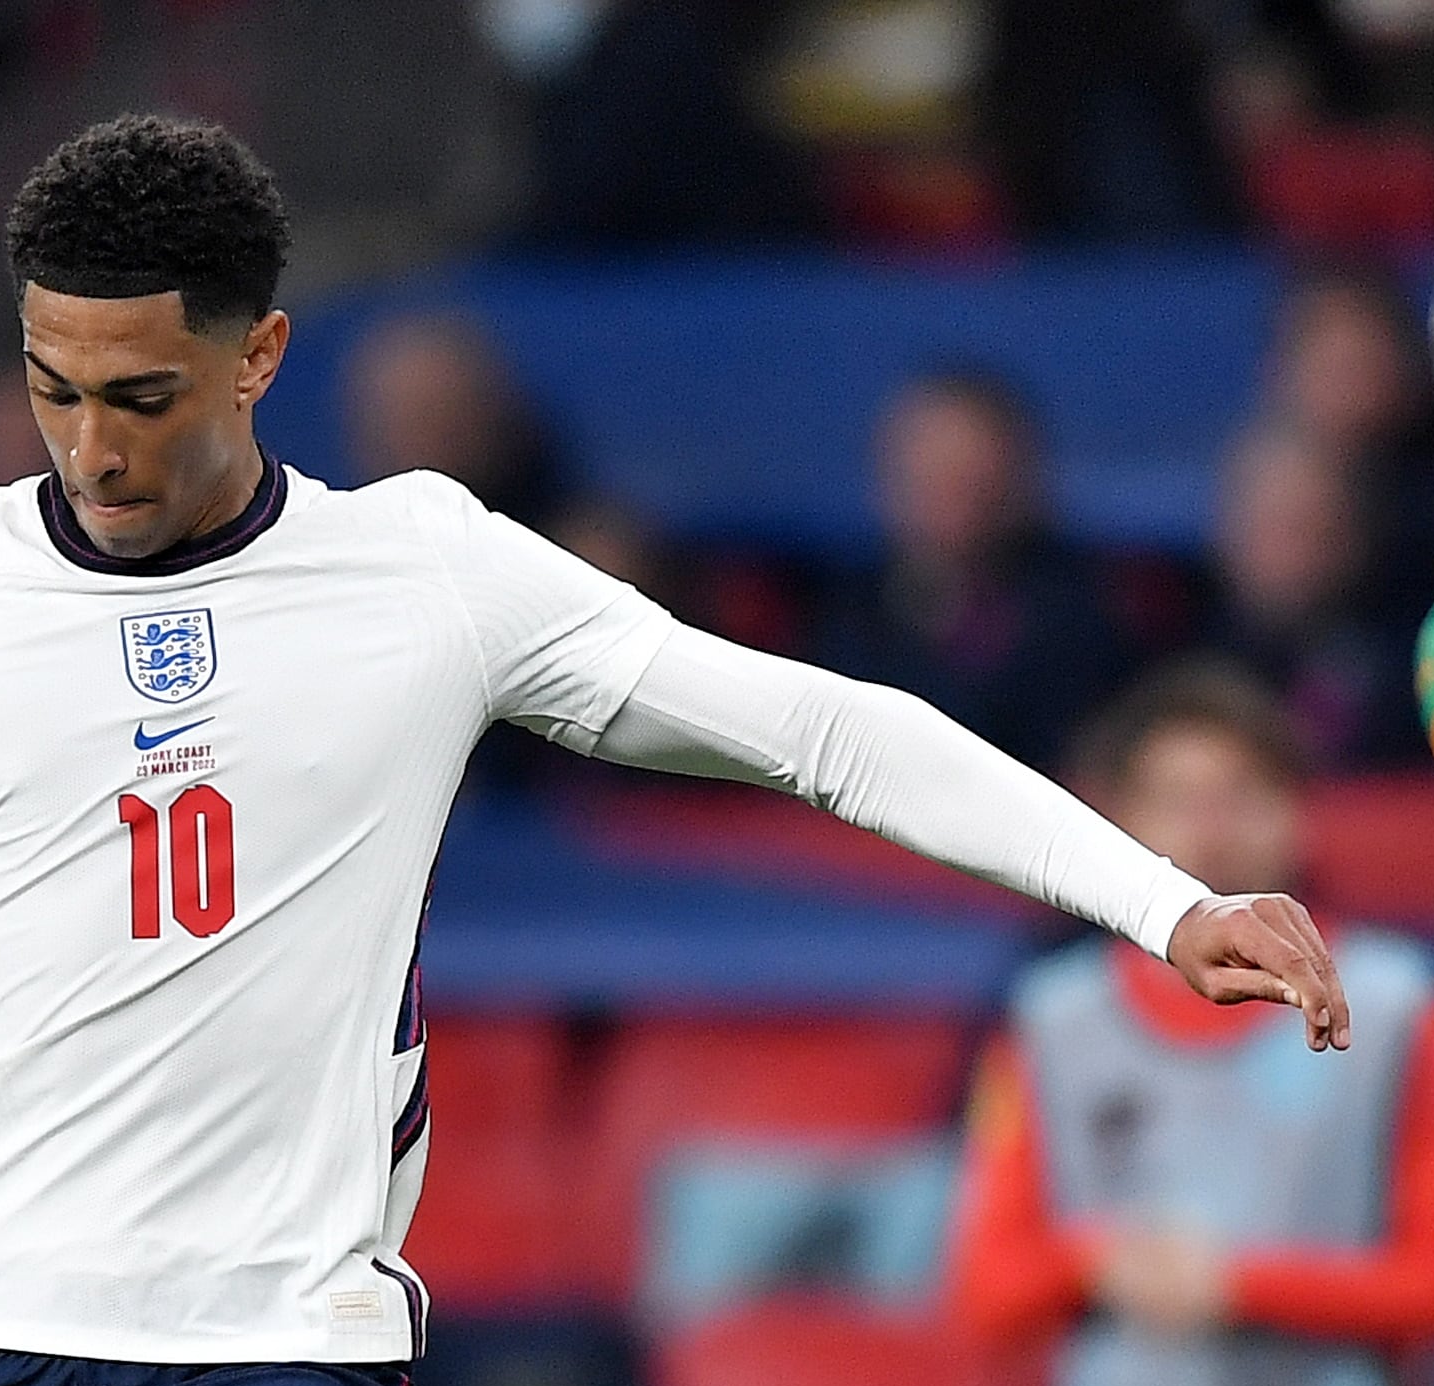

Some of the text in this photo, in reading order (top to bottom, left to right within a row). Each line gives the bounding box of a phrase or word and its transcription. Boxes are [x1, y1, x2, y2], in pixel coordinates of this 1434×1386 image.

[141, 745, 211, 763] IVORY COAST
[152, 761, 189, 775] MARCH
[192, 758, 216, 771] 2022
[118, 784, 235, 939] 10
